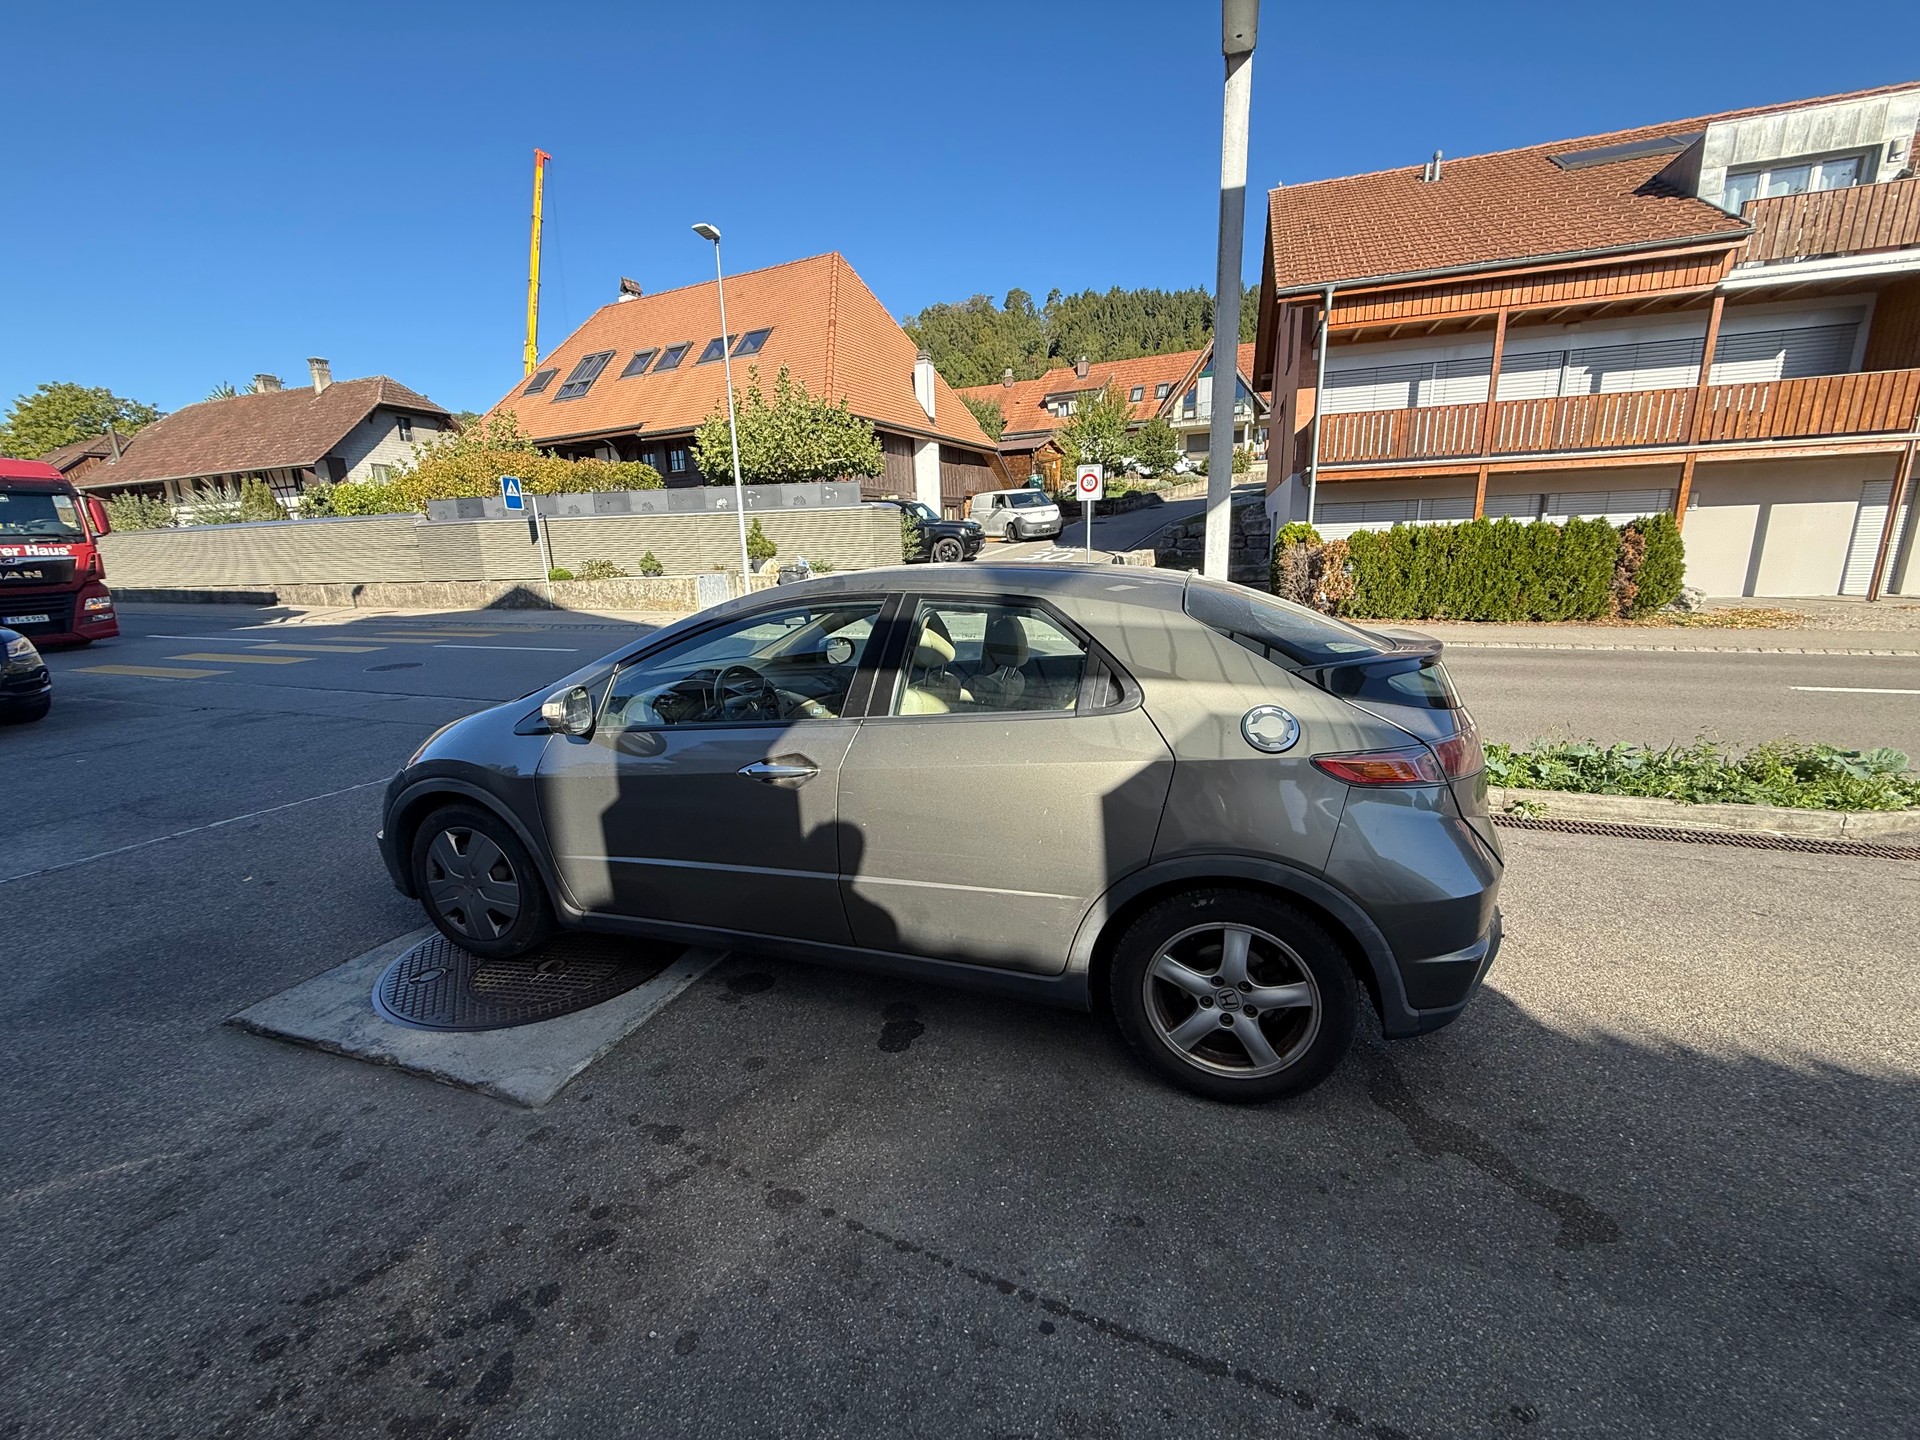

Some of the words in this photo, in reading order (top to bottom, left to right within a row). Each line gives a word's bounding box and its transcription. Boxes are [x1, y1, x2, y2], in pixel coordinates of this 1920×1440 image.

[1085, 479, 1094, 487] 30
[24, 545, 69, 556] Haus
[1014, 551, 1075, 561] 30
[0, 570, 43, 580] AN
